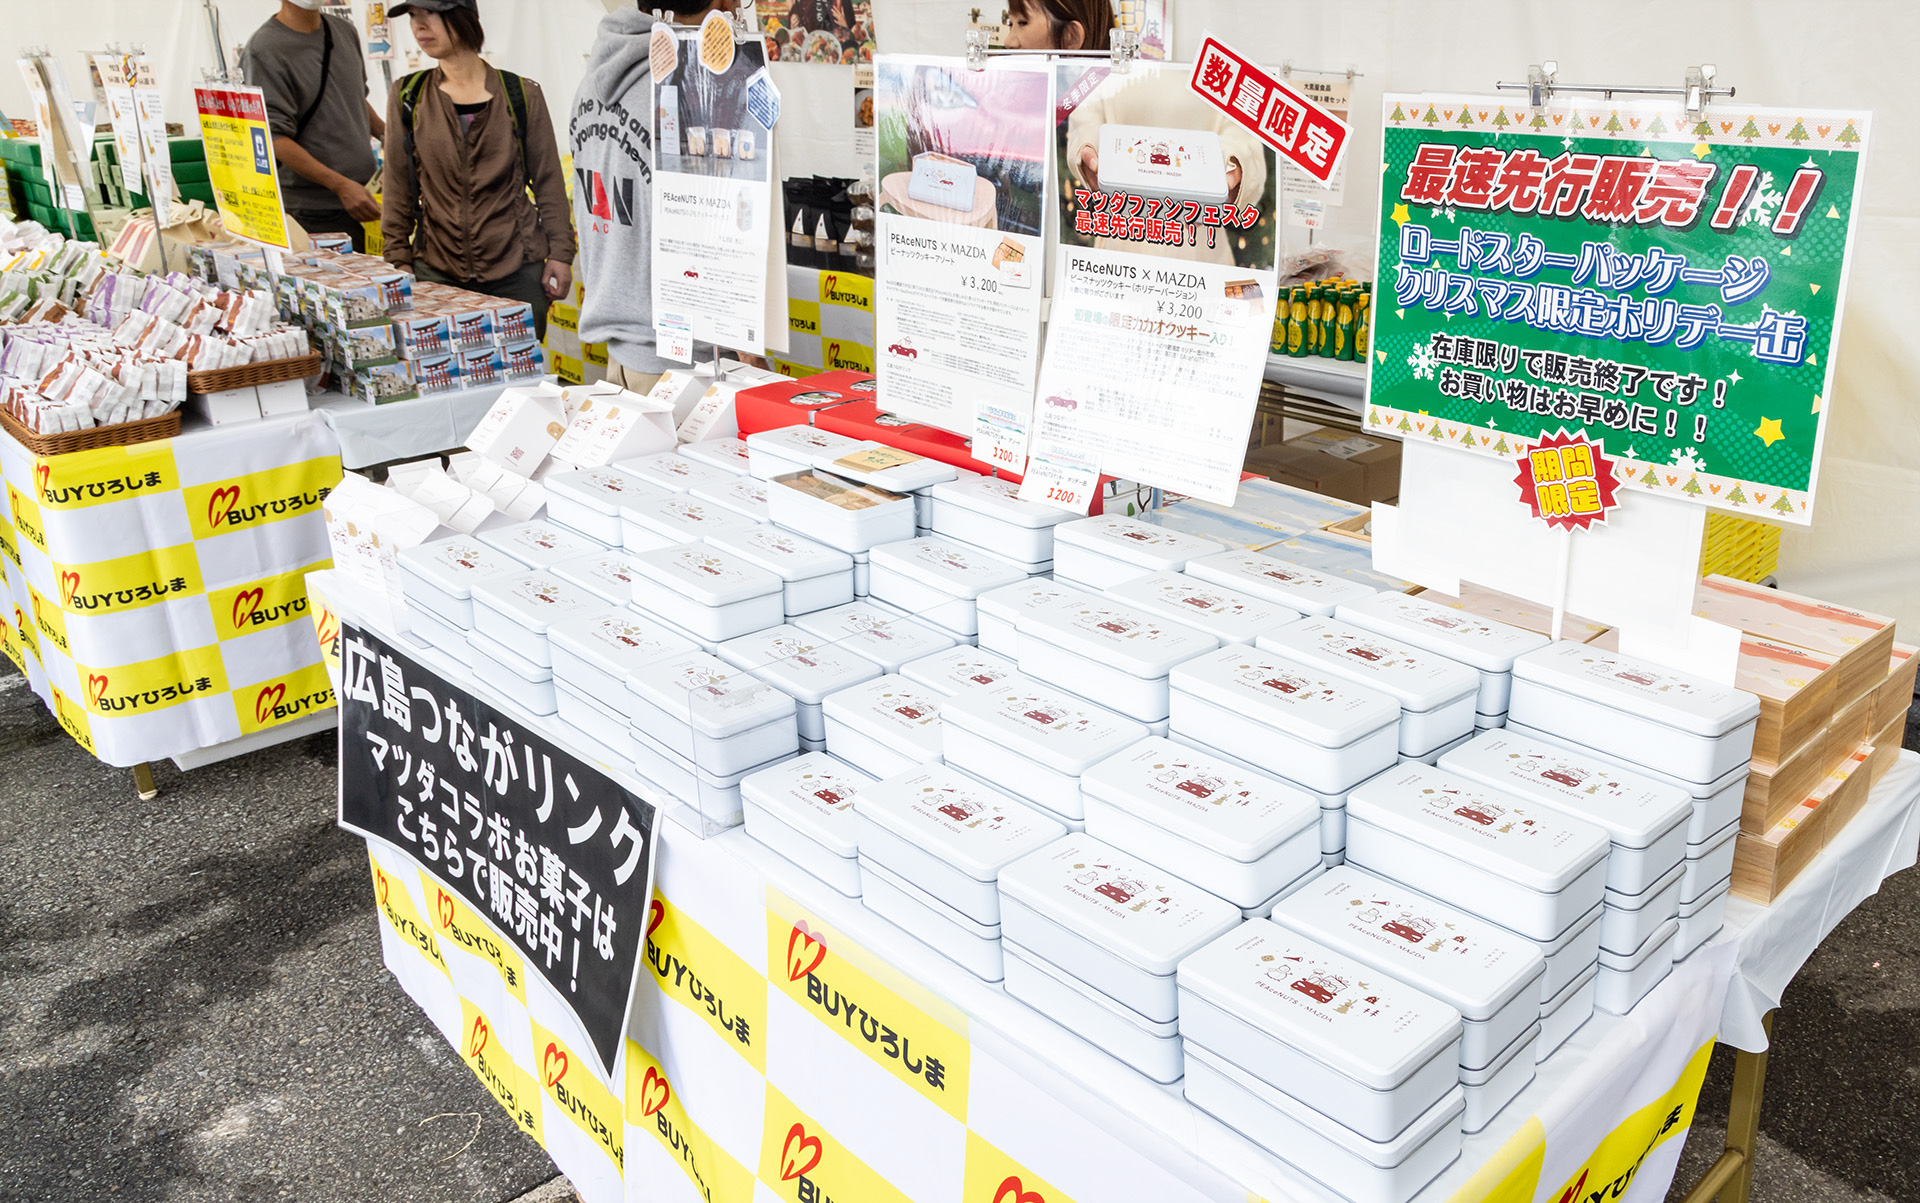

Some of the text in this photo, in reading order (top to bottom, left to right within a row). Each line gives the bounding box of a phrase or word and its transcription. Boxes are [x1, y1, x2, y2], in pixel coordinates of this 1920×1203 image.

[1061, 71, 1099, 111] 冬季限定
[1201, 53, 1335, 168] 数量限定
[575, 168, 634, 227] VAN
[663, 192, 697, 205] PEAceNUTS
[706, 198, 732, 210] MAZDA
[1401, 143, 1824, 237] 最速先行販売！！
[1074, 189, 1261, 231] マツダファンフェスタ
[1074, 210, 1217, 249] 最速先行販売！！
[890, 233, 938, 251] PEAceNUTS
[950, 243, 987, 260] MAZDA
[890, 248, 955, 266] ピーナッツクッキーアソート
[1399, 225, 1771, 304] ロードスターパッケージ
[1071, 259, 1137, 279] PEAceNUTS
[1155, 270, 1207, 290] MAZDA
[830, 291, 869, 307] BUYひろしま
[1395, 266, 1809, 367] クリスマス限定ホリデー缶
[1074, 308, 1235, 347] 初登場の限定カカオクッキー入り！
[1431, 333, 1728, 409] 在庫限りで販売終了です！
[1440, 368, 1709, 443] お買い物はお早めに！！
[1531, 444, 1596, 483] 期間
[44, 471, 162, 504] BUYひろしま
[227, 487, 333, 526] BUYひろしま
[1536, 480, 1604, 519] 限定
[72, 577, 187, 610] BUYひろしま
[99, 676, 212, 712] BUYひろしま
[342, 635, 644, 886] 広島つながリンク
[365, 730, 618, 962] マツダコラボお菓子は
[1470, 826, 1498, 841] MAZDA
[396, 794, 580, 994] こちらで販売中！
[1103, 905, 1127, 920] MAZDA
[1347, 922, 1392, 946] PEAceNUTS
[1398, 944, 1427, 961] MAZDA
[646, 937, 751, 1047] BUYひろしま
[1254, 980, 1299, 1006] PEAceNUTS
[1304, 1005, 1333, 1023] MAZDA
[807, 971, 946, 1092] BUYひろしま
[478, 1052, 536, 1130] BUYひろしま
